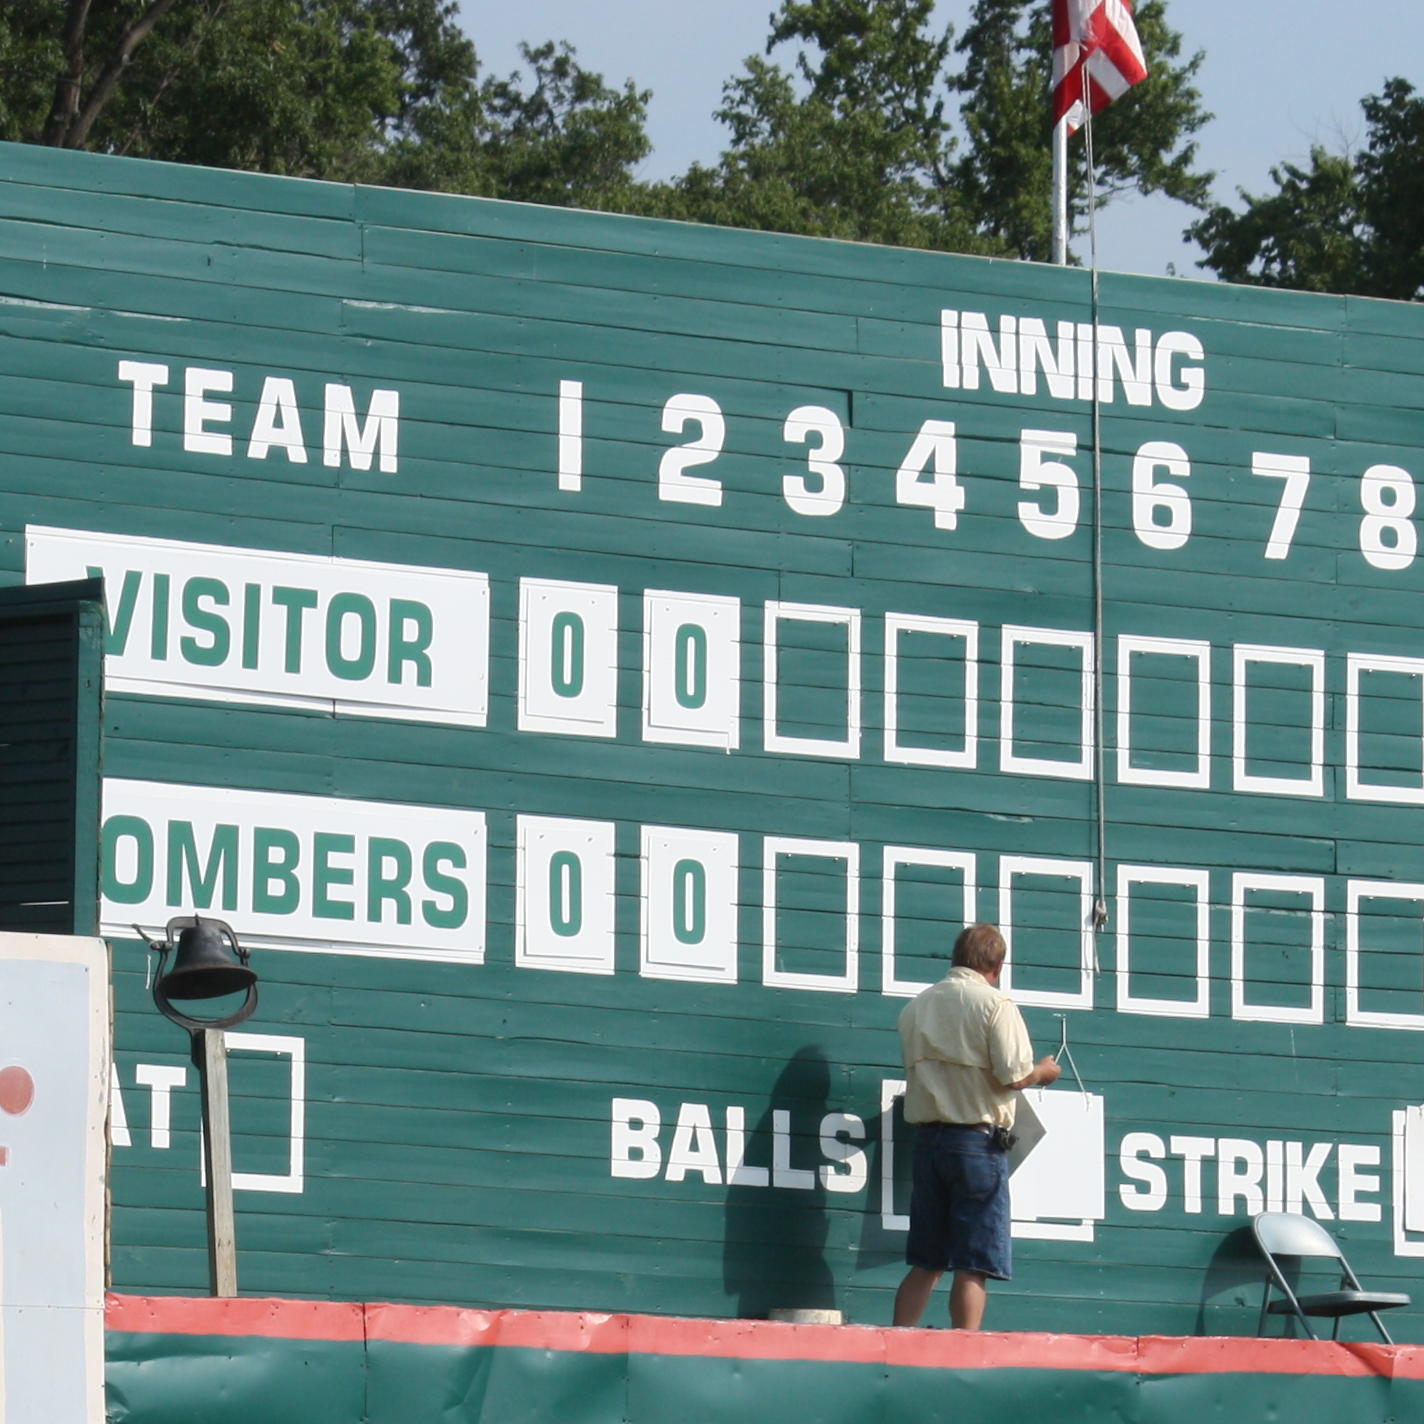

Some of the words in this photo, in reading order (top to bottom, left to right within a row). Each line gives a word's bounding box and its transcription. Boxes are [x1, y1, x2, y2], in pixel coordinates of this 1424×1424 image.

[941, 309, 1206, 411] INNING
[119, 360, 399, 473] TEAM
[659, 394, 725, 506] 2
[783, 406, 845, 515] 3
[896, 420, 965, 530] 4
[1018, 429, 1079, 539] 5
[1132, 442, 1191, 549] 6
[1251, 452, 1310, 559] 7
[1360, 465, 1417, 569] 8
[611, 1098, 867, 1192] BALLS
[1119, 1132, 1382, 1221] STRIKE
